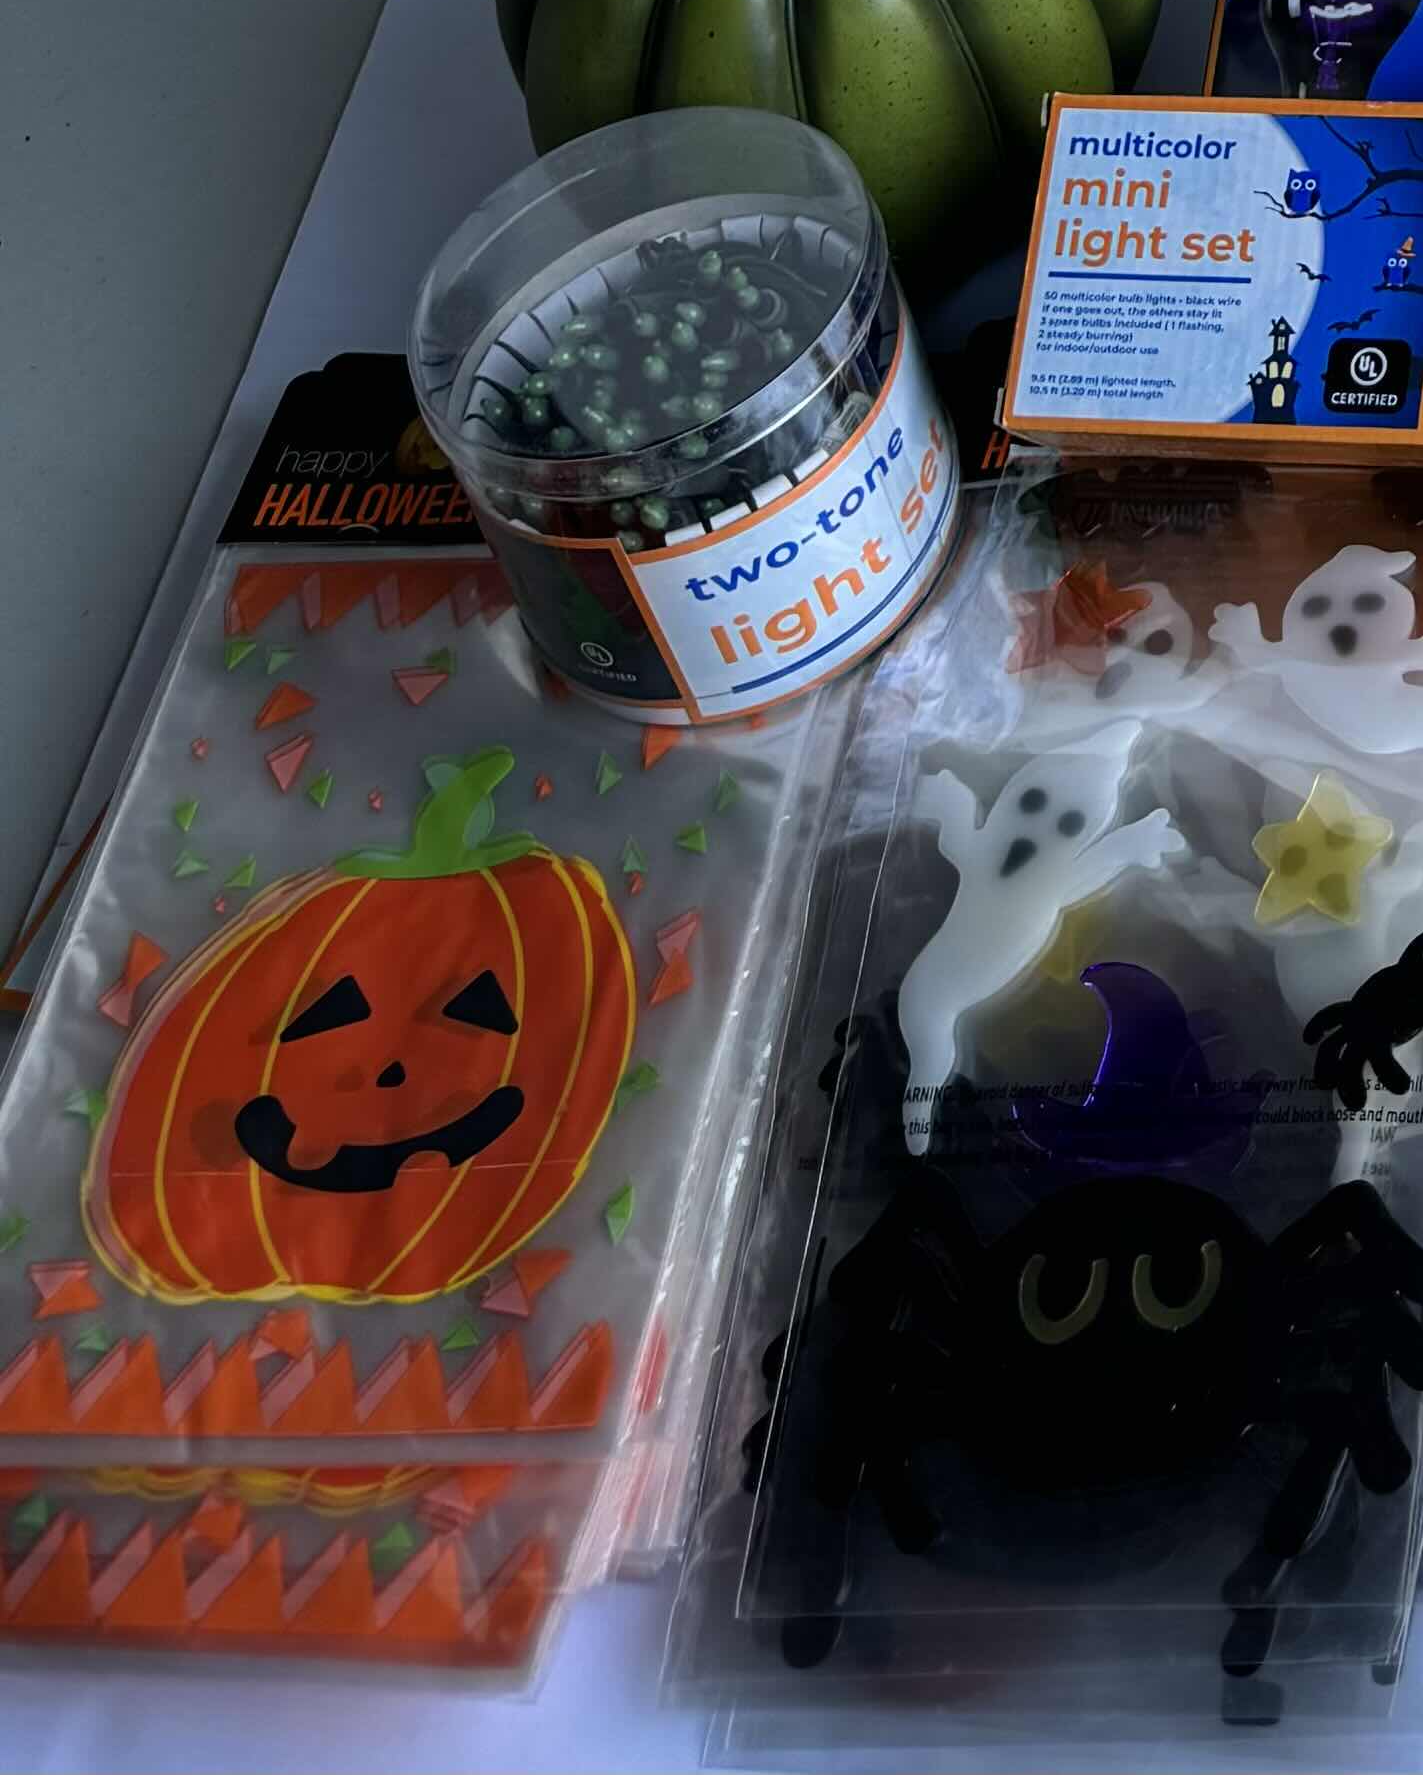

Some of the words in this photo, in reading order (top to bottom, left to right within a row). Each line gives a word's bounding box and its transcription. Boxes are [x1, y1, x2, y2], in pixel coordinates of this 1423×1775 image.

[1069, 131, 1237, 161] multicolor
[1062, 168, 1173, 209] mini
[1053, 218, 1166, 268] light
[1181, 228, 1257, 263] set
[1044, 291, 1058, 300] 50
[1060, 292, 1116, 303] multicolor
[1119, 293, 1143, 303] bulb
[1145, 293, 1176, 305] lights
[1186, 295, 1214, 306] black
[1218, 297, 1242, 307] wire
[1042, 304, 1050, 313] if
[1052, 306, 1072, 315] one
[1076, 306, 1101, 317] goes
[1104, 306, 1125, 317] out,
[1128, 307, 1146, 317] the
[1149, 308, 1183, 318] others
[1186, 309, 1208, 320] stay
[1211, 309, 1222, 319] lit
[1040, 316, 1046, 325] 3
[1049, 319, 1079, 328] spare
[1082, 317, 1112, 328] bulbs
[1114, 318, 1161, 330] included
[1178, 321, 1225, 333] flashing,
[1038, 329, 1045, 339] 2
[1047, 330, 1084, 341] steady
[1087, 331, 1133, 342] burning)
[1036, 343, 1051, 352] for
[1054, 343, 1136, 355] indoor/outdoor
[1139, 346, 1159, 355] use
[1101, 376, 1138, 387] lighted
[1140, 377, 1176, 387] length,
[1104, 388, 1127, 398] total
[1130, 388, 1164, 400] length
[1331, 391, 1398, 407] CERTIFIED
[274, 442, 389, 479] happy
[684, 425, 904, 603] two-tone
[709, 537, 892, 667] light
[899, 418, 946, 535] set
[1292, 1107, 1323, 1123] block
[1327, 1109, 1355, 1121] nose
[1359, 1106, 1384, 1122] and
